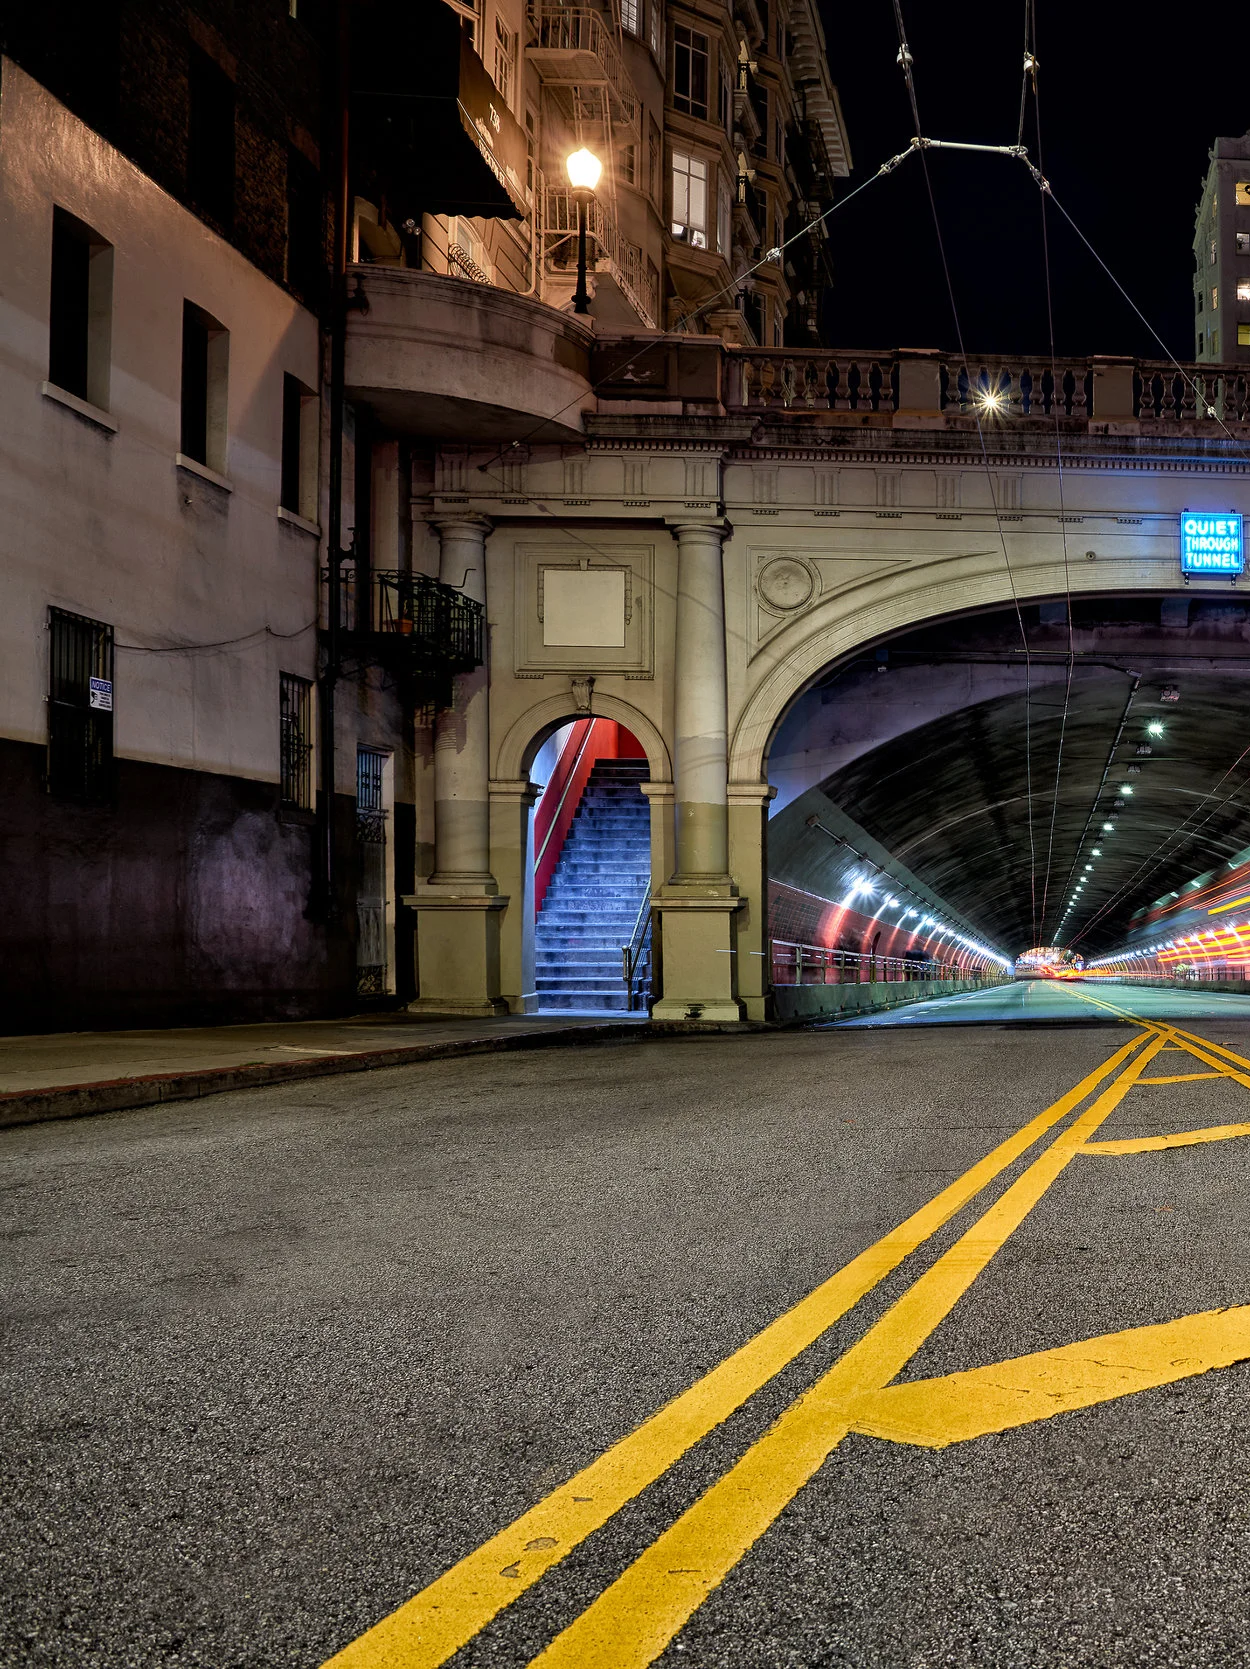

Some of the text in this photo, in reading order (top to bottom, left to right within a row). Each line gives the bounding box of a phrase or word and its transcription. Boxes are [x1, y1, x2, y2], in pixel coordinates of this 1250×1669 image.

[1184, 519, 1238, 535] QUIET
[1184, 536, 1239, 552] THROUGH
[1185, 552, 1239, 568] TUNNEL
[91, 680, 111, 692] NOTICE
